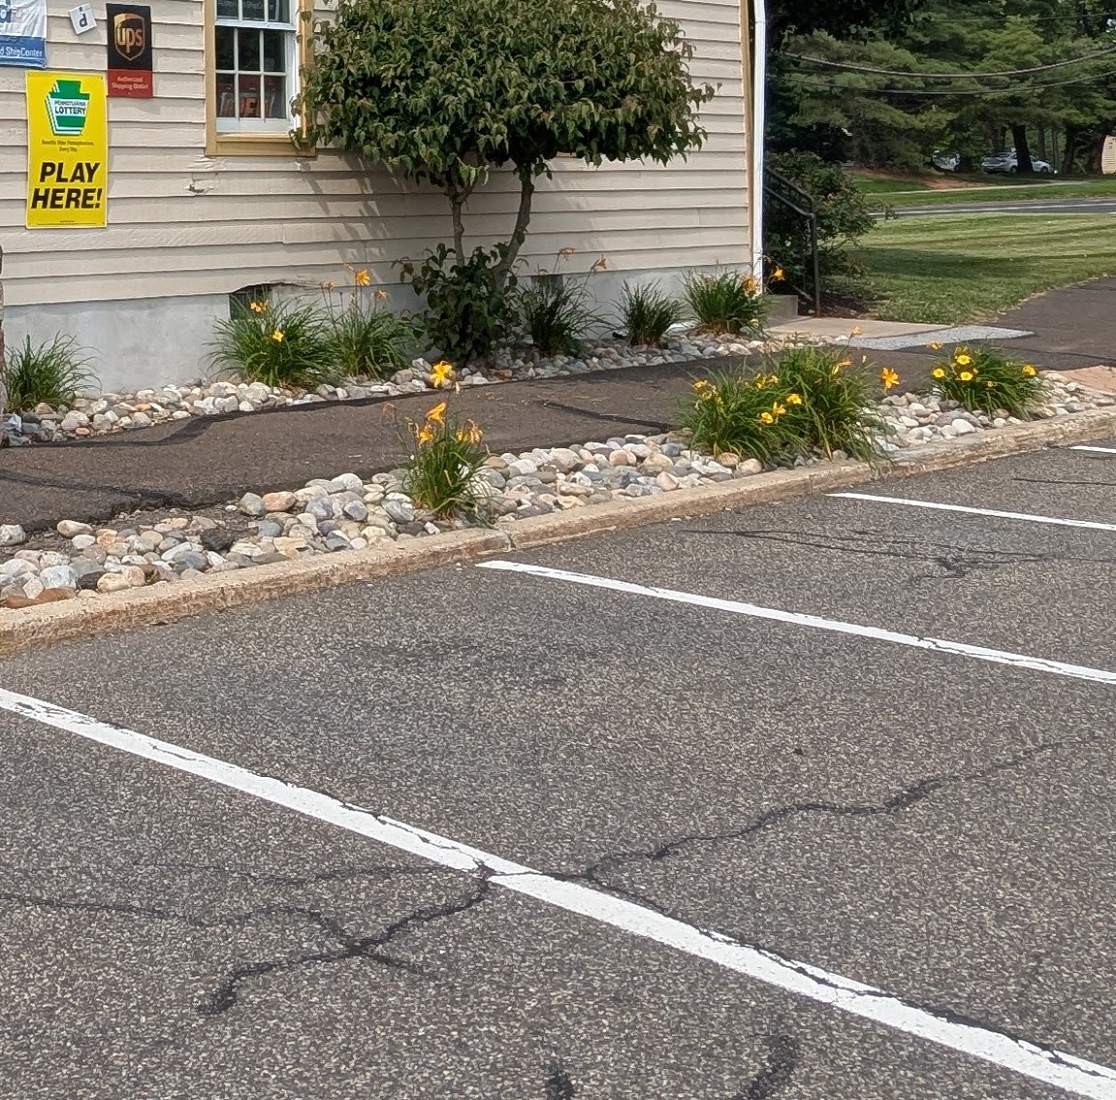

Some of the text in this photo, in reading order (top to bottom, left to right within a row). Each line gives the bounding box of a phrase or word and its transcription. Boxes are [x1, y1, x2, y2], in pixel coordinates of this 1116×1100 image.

[117, 27, 143, 53] ups
[55, 106, 86, 114] LOTTERY
[39, 162, 100, 183] PLAY
[31, 188, 103, 209] HERE!
